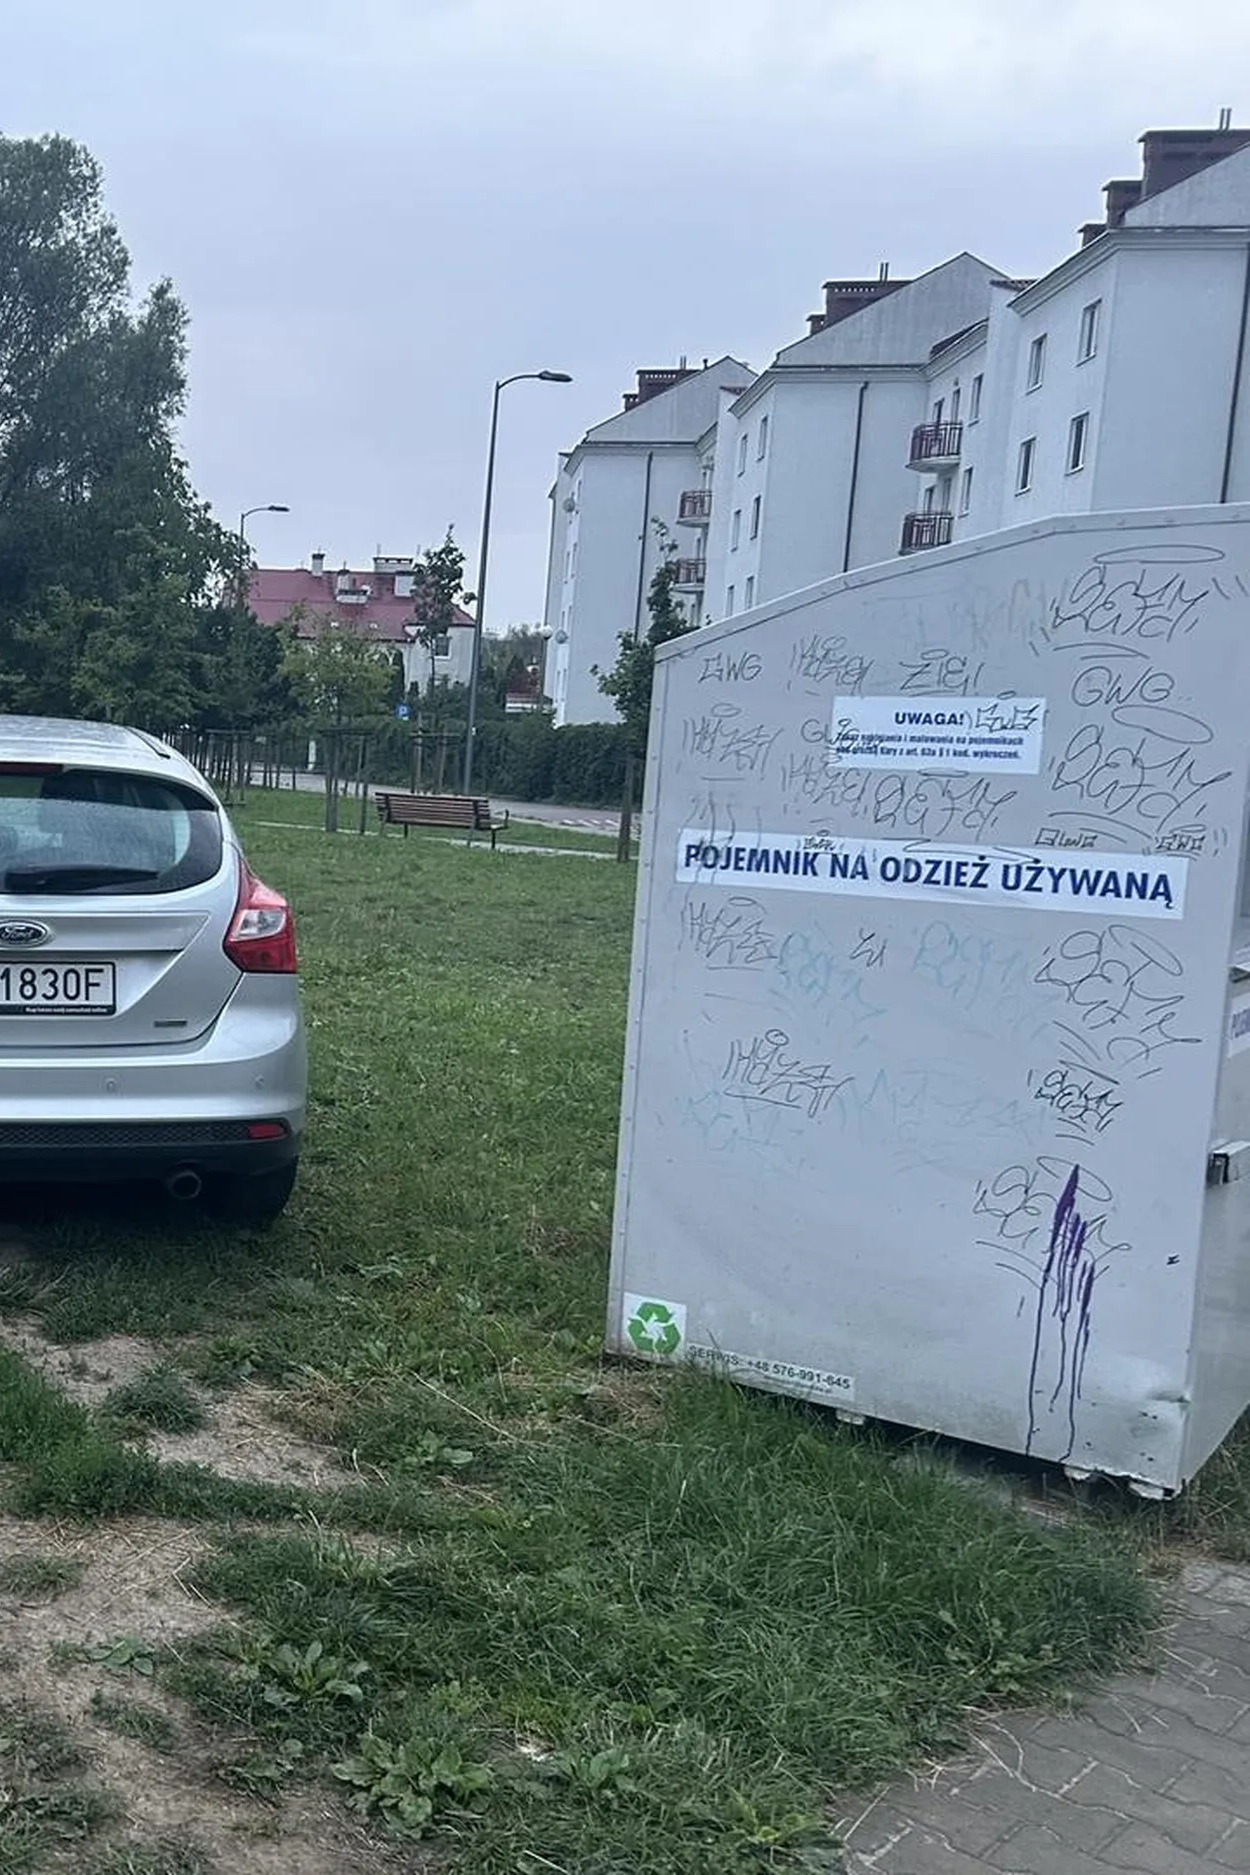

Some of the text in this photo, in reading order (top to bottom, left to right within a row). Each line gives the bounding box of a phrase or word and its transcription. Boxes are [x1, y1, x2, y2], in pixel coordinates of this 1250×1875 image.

[895, 712, 964, 725] UWAGA!
[684, 844, 1174, 909] POJEMNIK NA ODZIEŻ UŻYWANĄ
[0, 967, 105, 1001] 1830F
